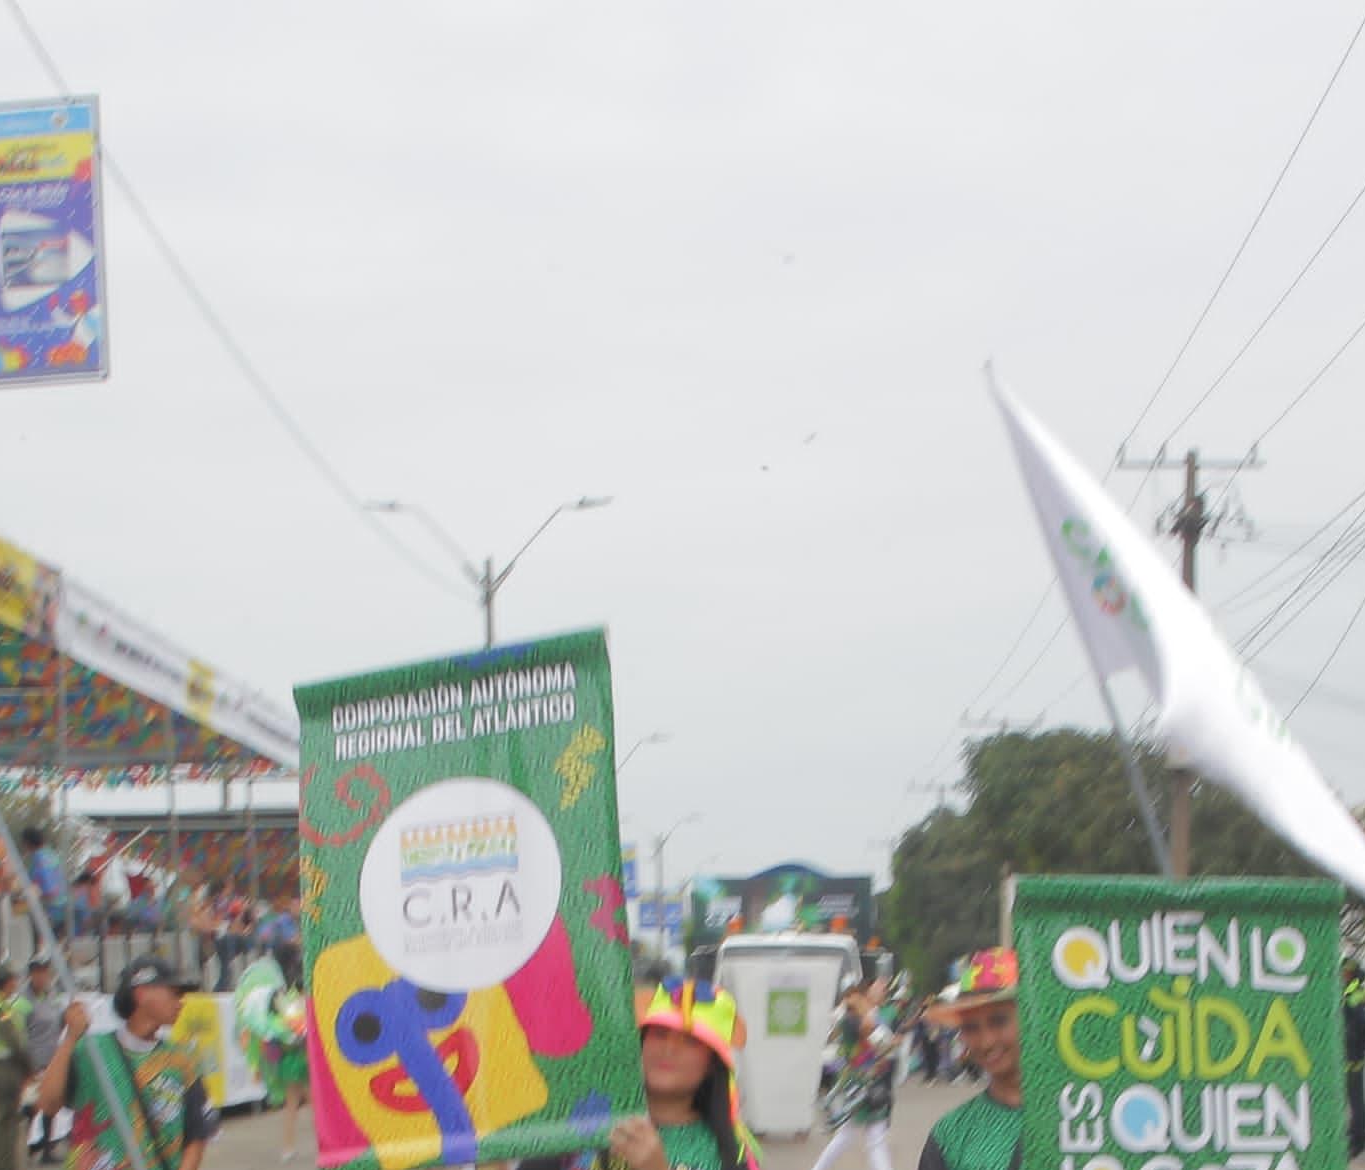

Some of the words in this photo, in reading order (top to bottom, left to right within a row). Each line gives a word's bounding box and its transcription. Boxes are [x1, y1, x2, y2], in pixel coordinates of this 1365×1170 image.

[332, 680, 463, 733] CORPORACIÓN
[470, 661, 577, 708] AUTÓNOMA
[335, 720, 426, 761] REGIONAL
[432, 711, 467, 745] DEL
[1051, 909, 1241, 991] QUIEN
[1250, 924, 1309, 994] LO
[1056, 974, 1312, 1080] CUIDA
[1058, 1081, 1104, 1154] ES
[1110, 1081, 1312, 1154] QUIEN
